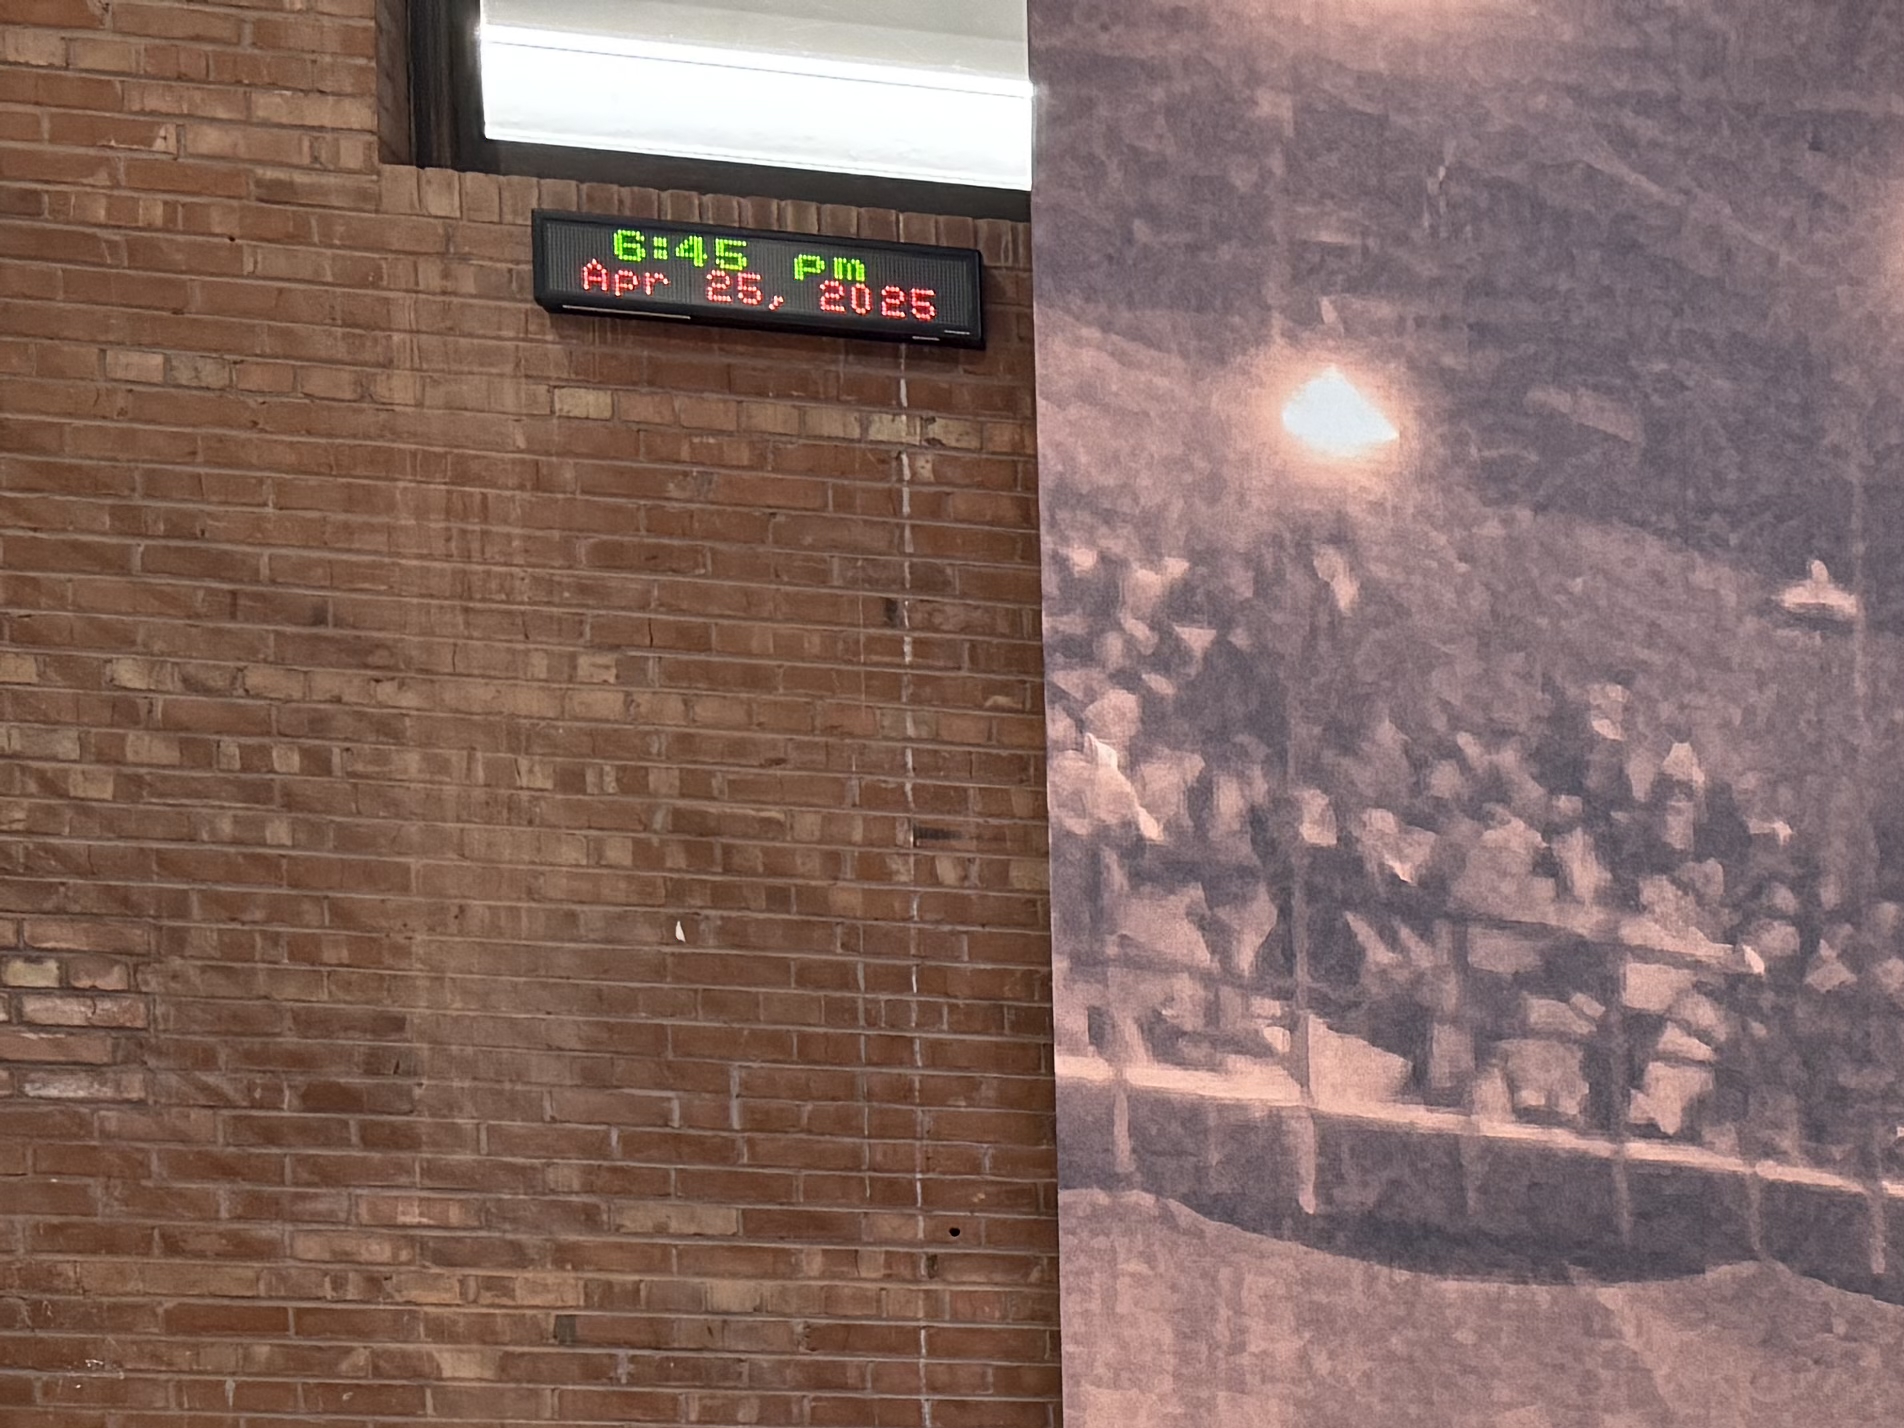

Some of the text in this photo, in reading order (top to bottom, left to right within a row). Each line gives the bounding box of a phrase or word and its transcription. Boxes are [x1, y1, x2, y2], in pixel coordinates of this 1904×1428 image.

[614, 229, 747, 270] 6:45
[583, 258, 937, 321] Apr 25, 2025
